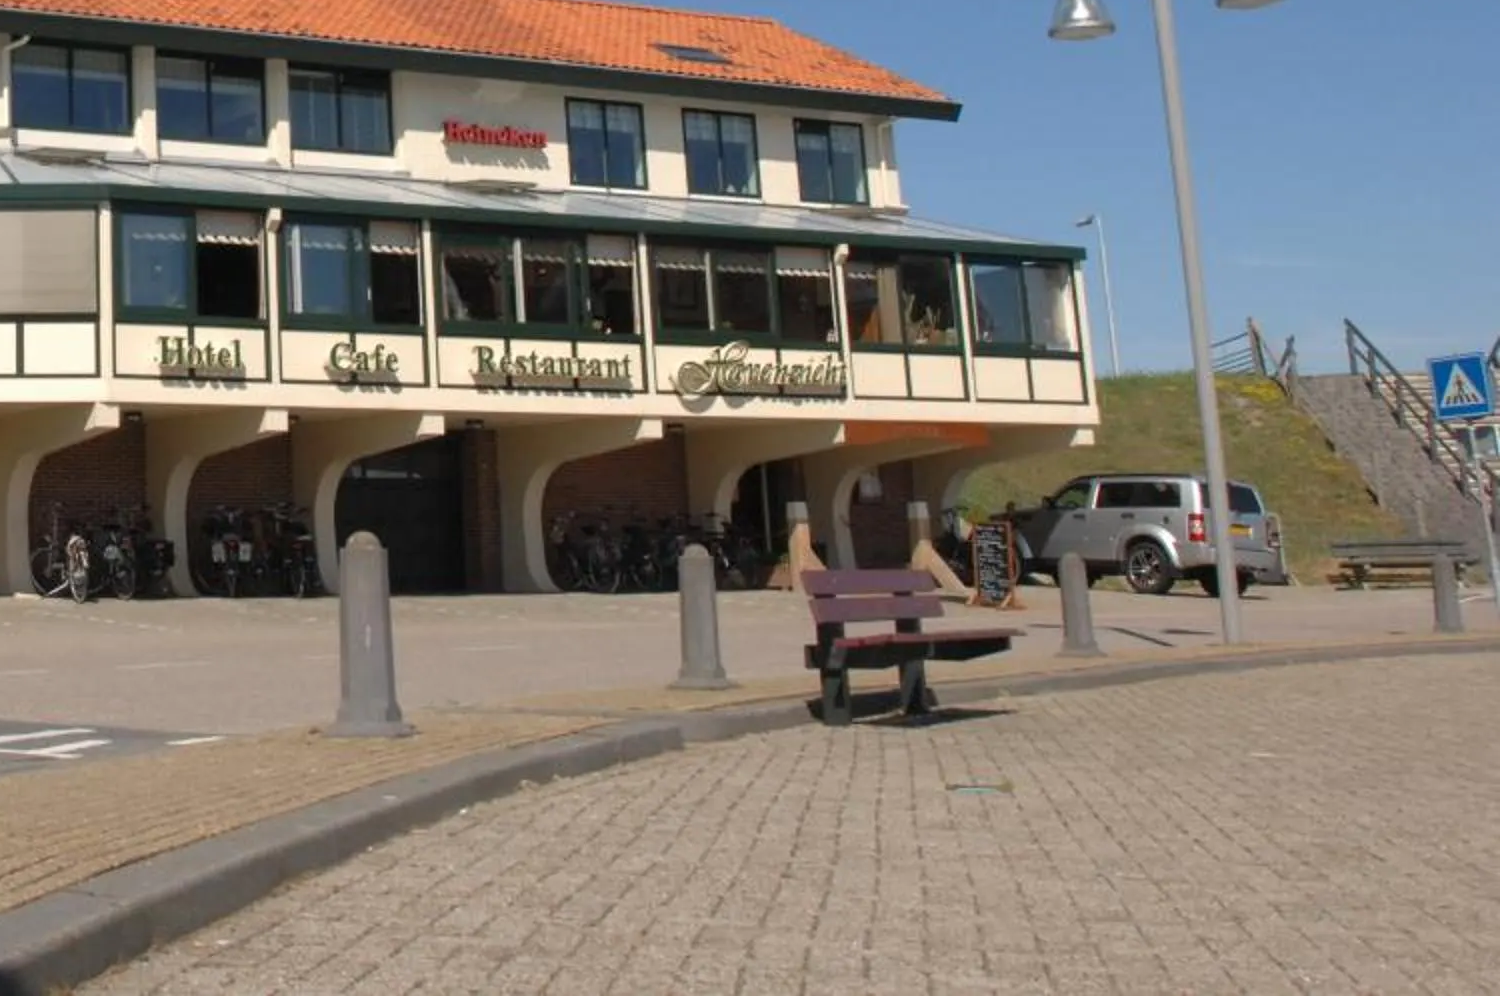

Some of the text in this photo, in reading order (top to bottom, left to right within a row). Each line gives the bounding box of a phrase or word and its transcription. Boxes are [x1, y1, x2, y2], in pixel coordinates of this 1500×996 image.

[442, 120, 548, 148] Heineken
[156, 335, 243, 369] Hotel
[329, 341, 400, 374] Cafe
[472, 345, 633, 379] Restaurant
